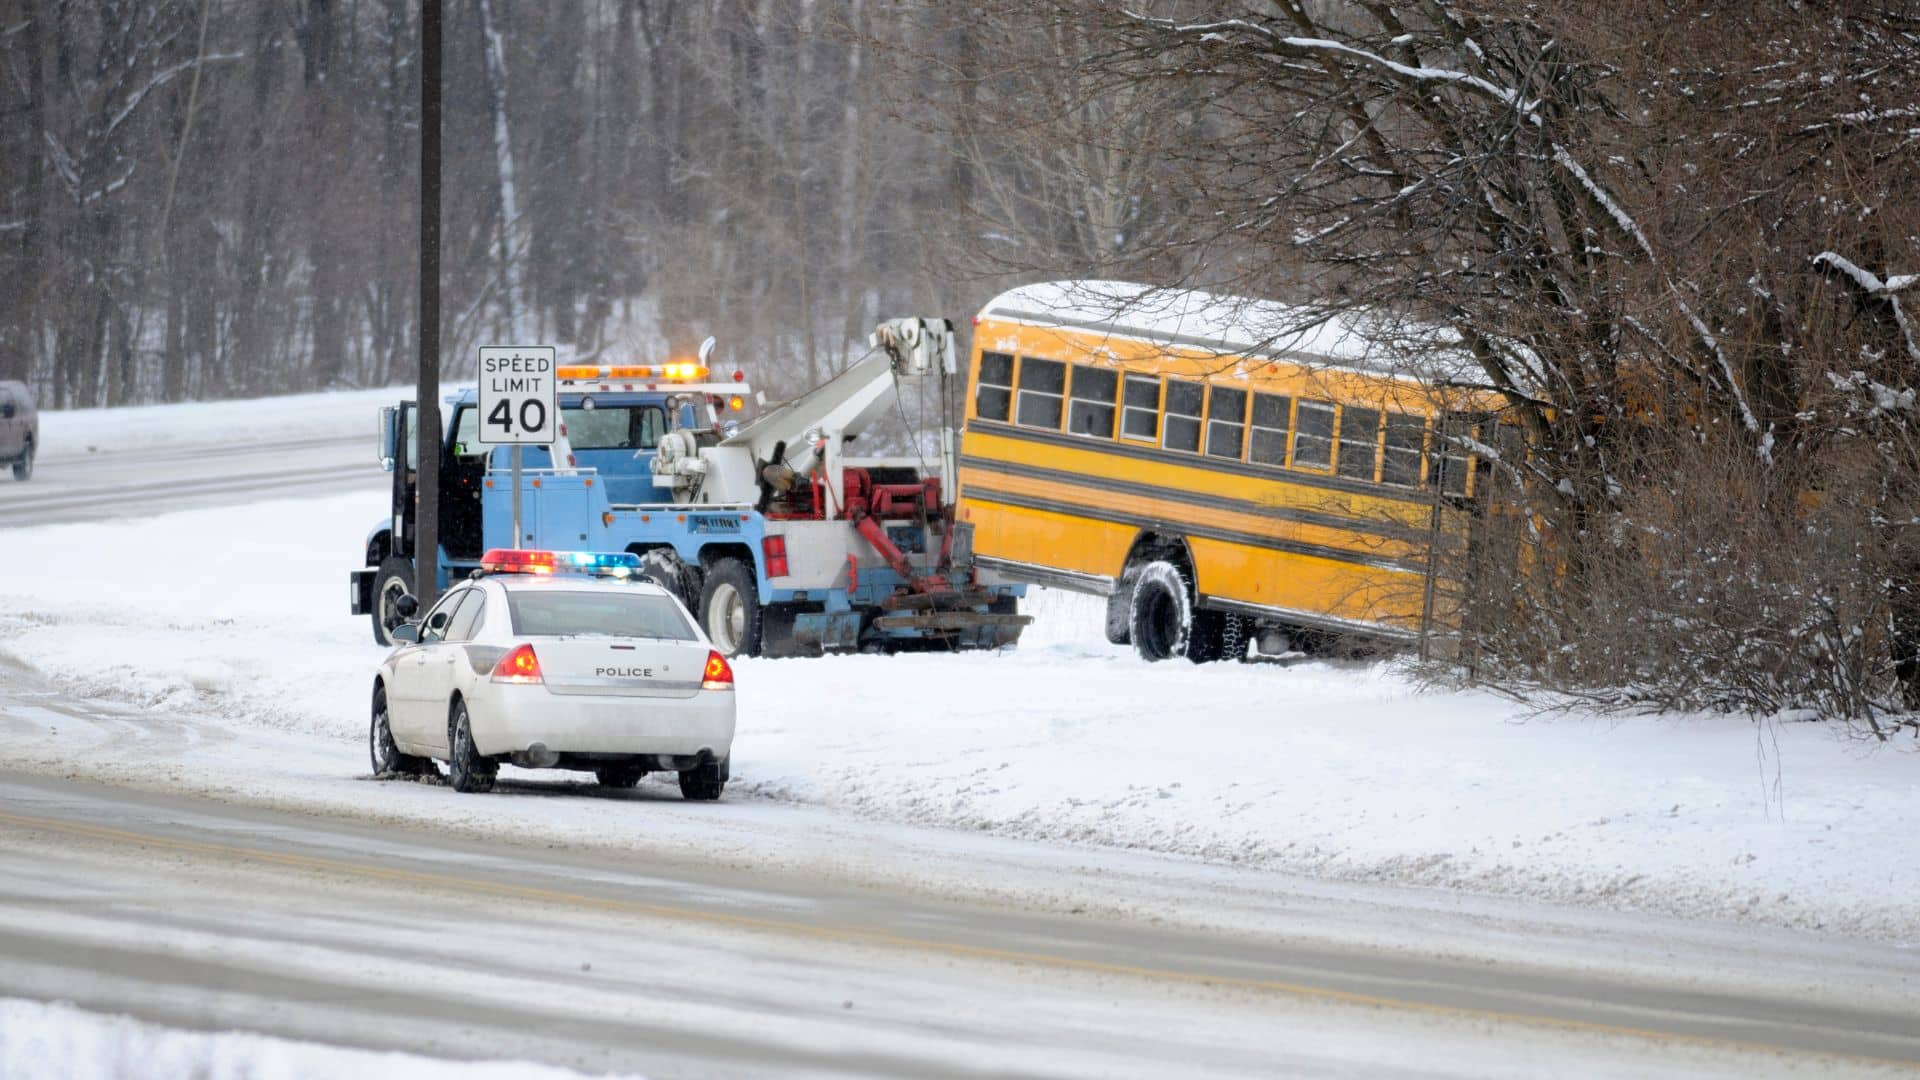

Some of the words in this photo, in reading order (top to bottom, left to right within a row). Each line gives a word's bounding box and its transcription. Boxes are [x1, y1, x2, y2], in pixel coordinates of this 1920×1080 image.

[485, 358, 549, 372] SPEED
[492, 378, 541, 392] LIMIT
[487, 398, 546, 433] 40
[596, 667, 653, 677] POLICE
